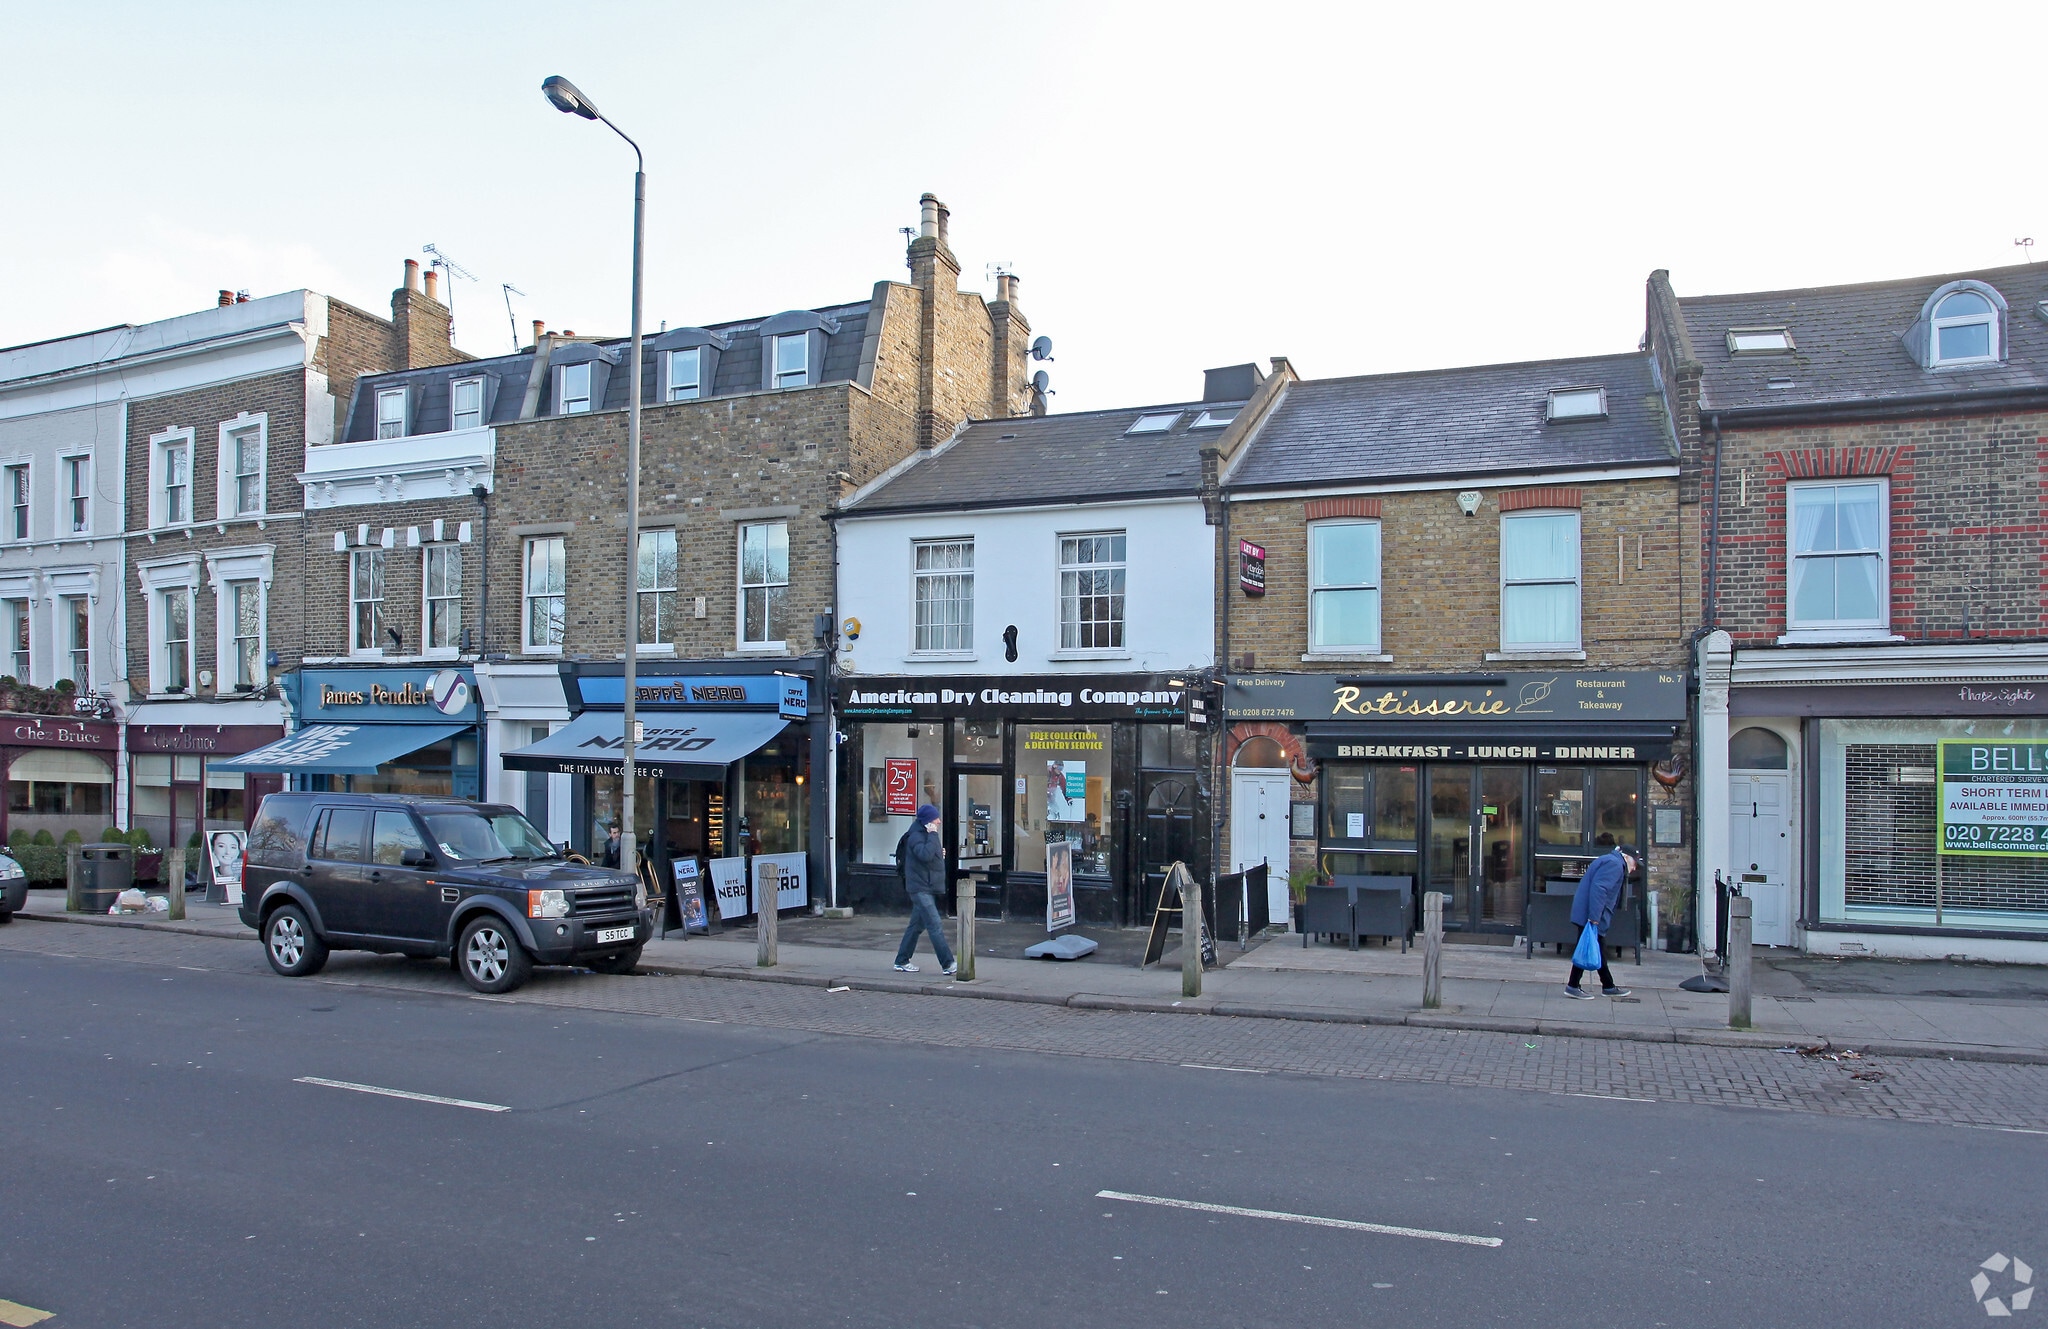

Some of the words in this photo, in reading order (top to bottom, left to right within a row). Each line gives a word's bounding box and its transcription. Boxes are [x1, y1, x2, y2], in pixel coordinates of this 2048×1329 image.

[1256, 679, 1285, 687] Delivery
[318, 683, 363, 710] James
[691, 686, 747, 701] NERO
[849, 689, 937, 704] American
[941, 689, 976, 705] Dry
[980, 689, 1072, 706] Cleaning
[1080, 689, 1182, 706] Company
[784, 697, 806, 708] NERO
[1332, 686, 1511, 715] Rotisserie
[1579, 701, 1622, 711] Takeaway
[14, 726, 53, 741] Chez
[58, 728, 100, 743] Bruce
[298, 726, 360, 740] WE
[1050, 732, 1097, 740] COLLECTION
[154, 733, 182, 748] Chez
[184, 734, 216, 750] Bruce
[266, 740, 352, 754] LIVE
[578, 736, 716, 751] NERO
[976, 736, 984, 747] 6
[1338, 746, 1451, 757] BREAKFAST
[1468, 747, 1537, 758] LUNCH
[1555, 747, 1635, 758] DINNER
[227, 753, 332, 765] HERE
[559, 764, 574, 772] THE
[577, 765, 610, 774] ITALIAN
[614, 767, 647, 776] COFEE
[1961, 788, 2003, 797] SHORT
[2007, 789, 2040, 798] TERM
[1950, 802, 2007, 810] AVAILABLE
[1946, 826, 1980, 840] 020
[1988, 827, 2034, 841] 7228
[1945, 841, 2048, 850] www.bellscommerci
[777, 875, 799, 891] RO
[719, 885, 747, 899] NERO
[606, 931, 614, 940] S5
[616, 929, 628, 938] TCC
